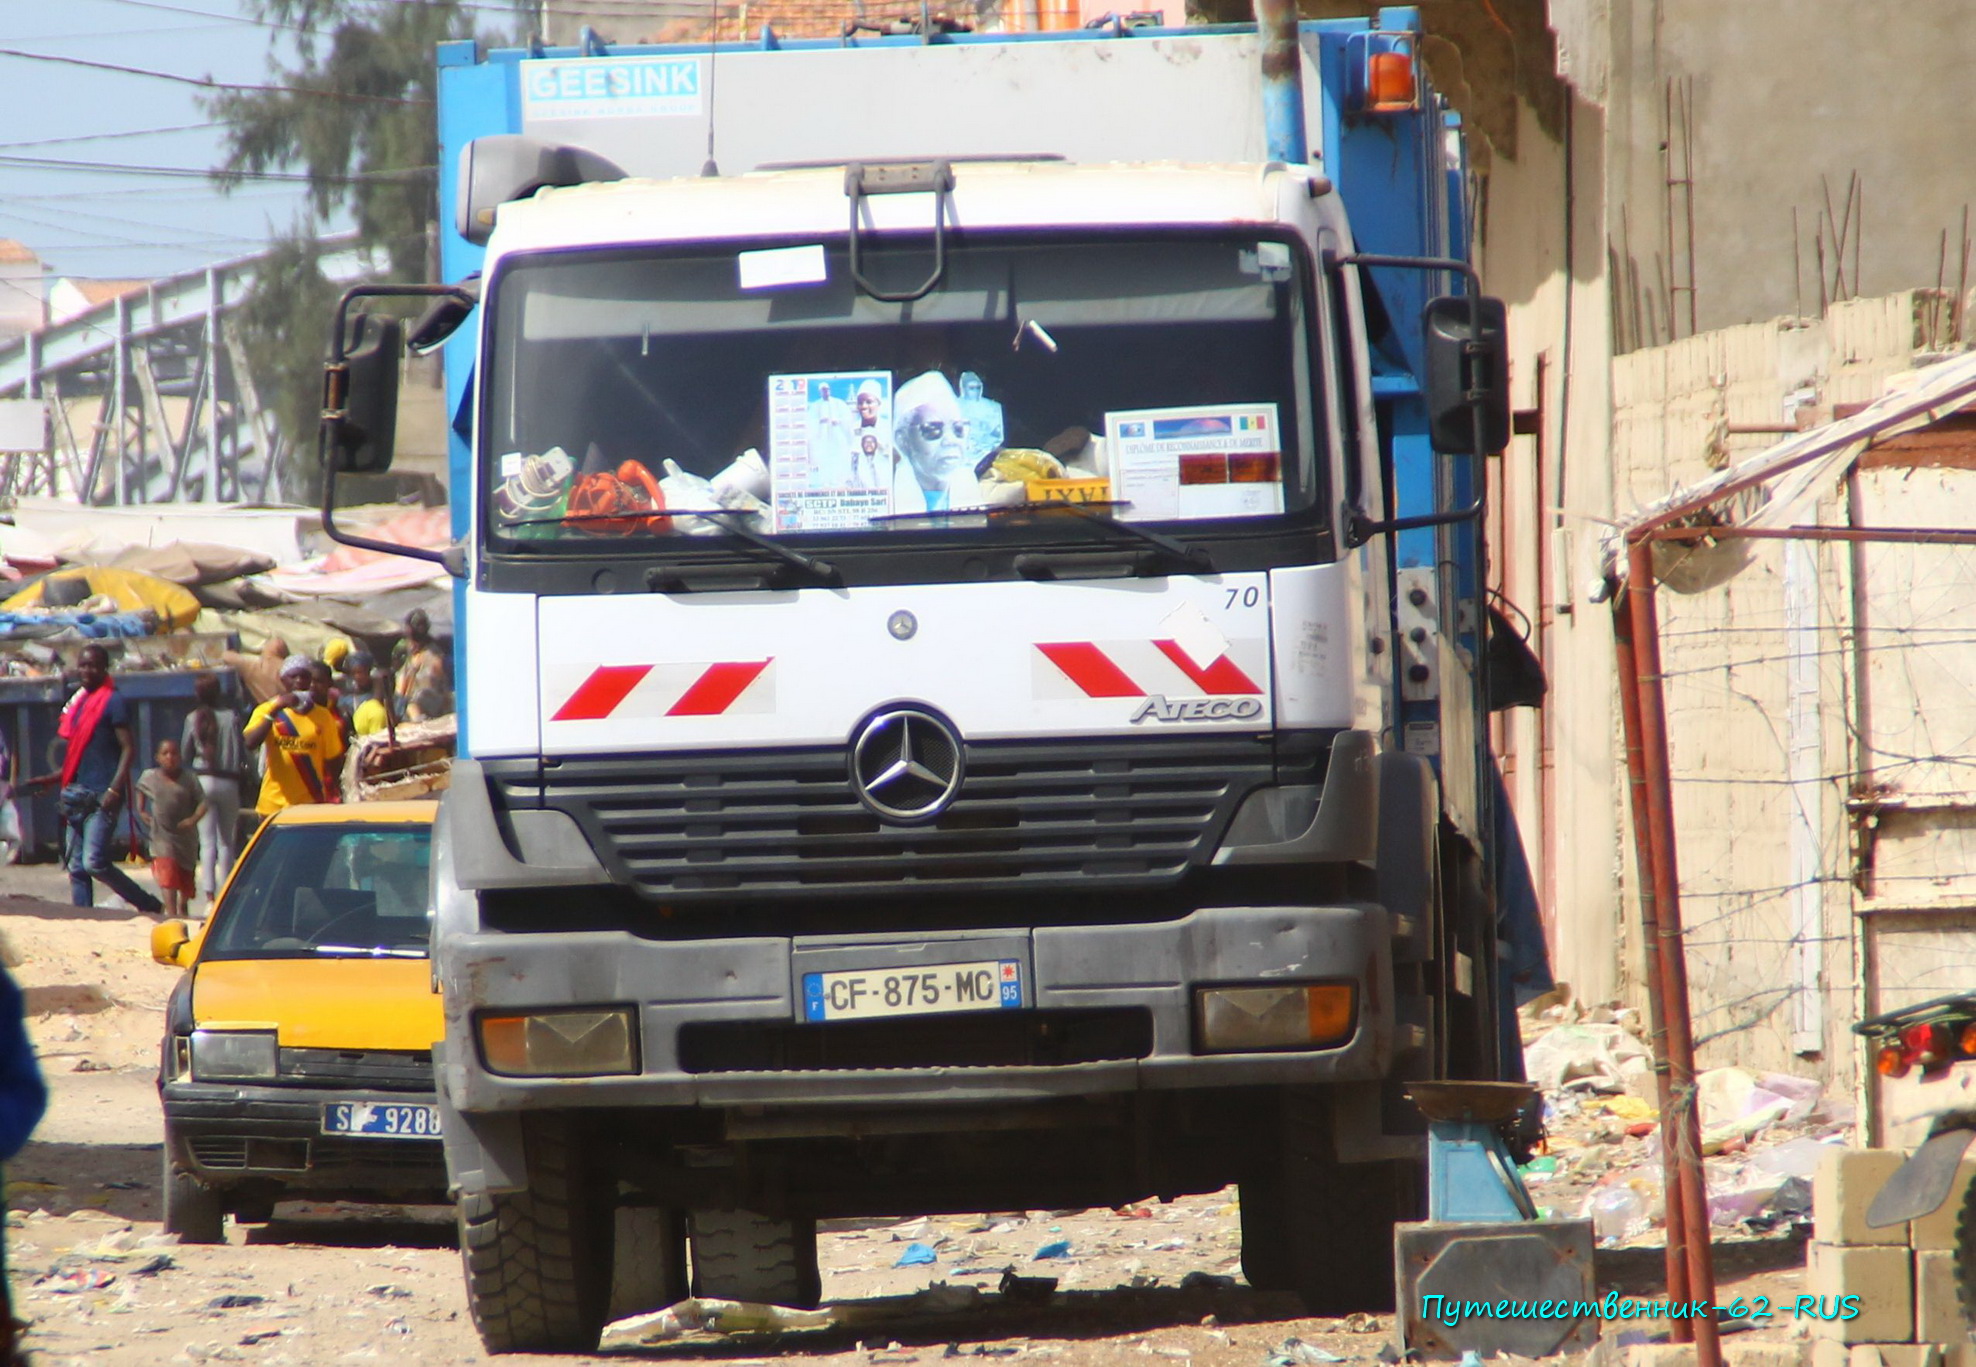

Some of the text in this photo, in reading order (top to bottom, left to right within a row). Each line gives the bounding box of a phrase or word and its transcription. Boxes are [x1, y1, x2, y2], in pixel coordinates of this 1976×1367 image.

[533, 63, 696, 98] GEESINK
[1224, 586, 1259, 610] 70
[1130, 694, 1262, 723] ATECO
[1002, 985, 1017, 1000] 95
[812, 1002, 819, 1011] F
